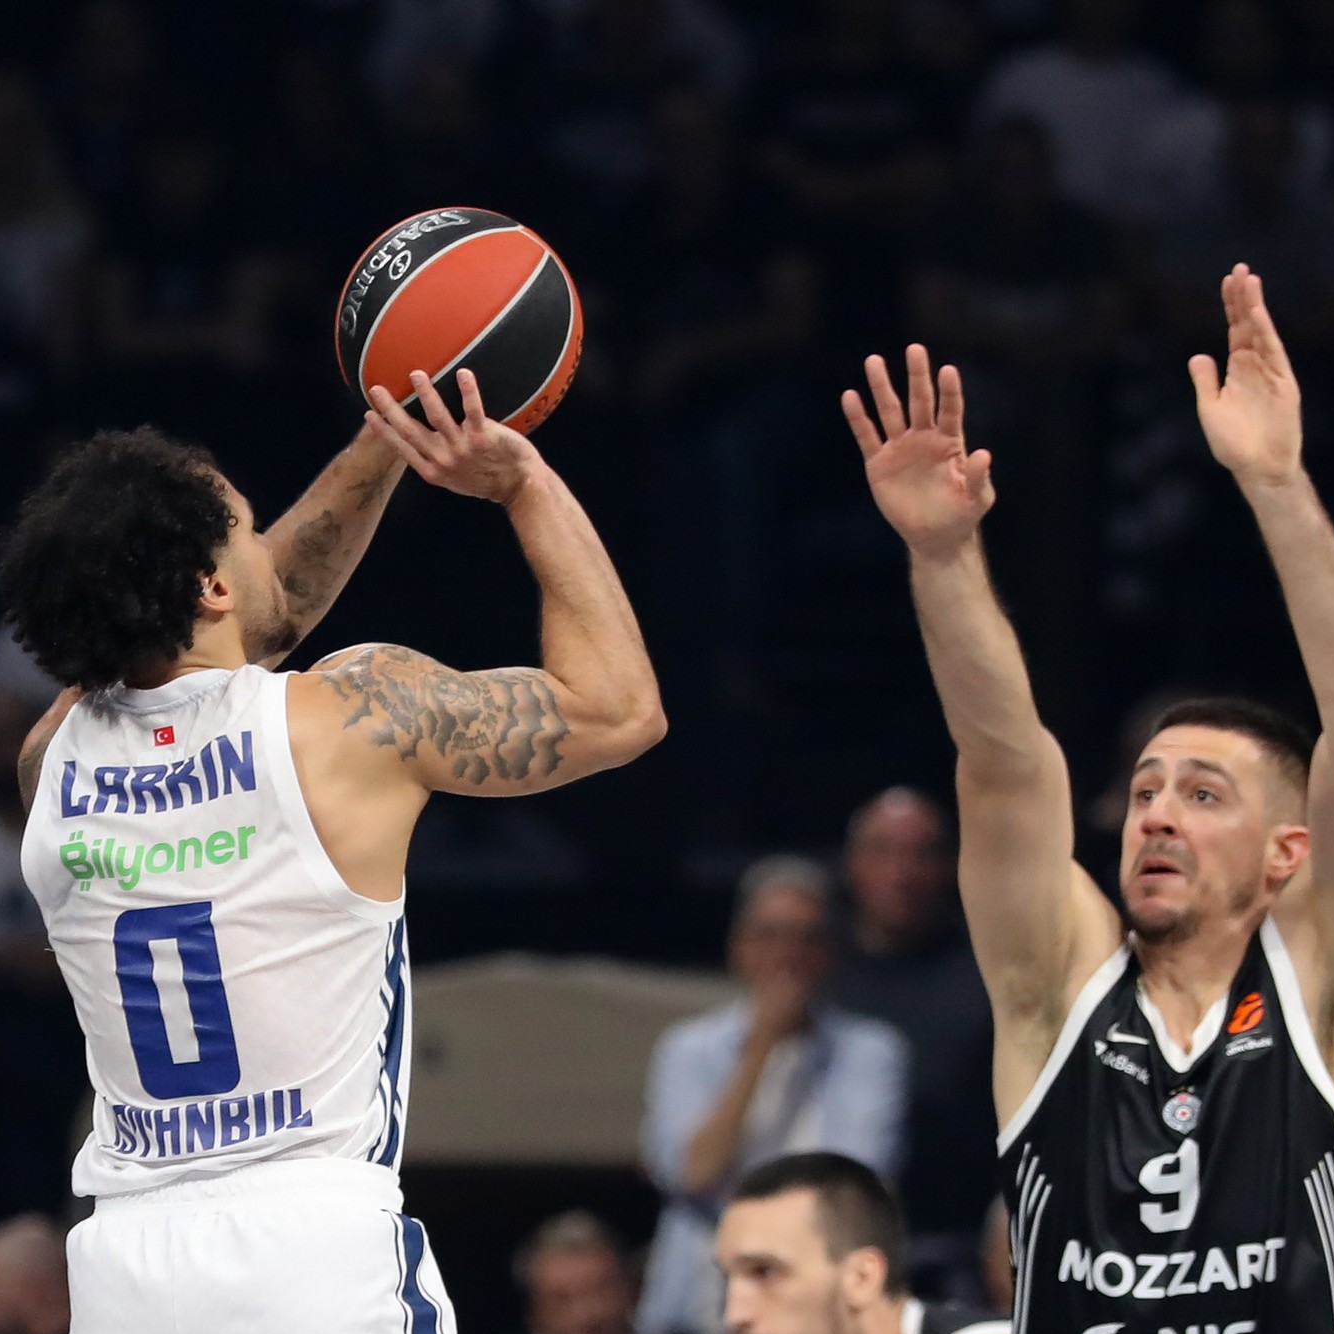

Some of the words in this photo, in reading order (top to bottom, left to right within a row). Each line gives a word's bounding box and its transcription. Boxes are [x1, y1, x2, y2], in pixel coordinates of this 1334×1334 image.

[61, 731, 257, 818] LARKIN
[59, 825, 256, 892] Bilyoner
[114, 901, 241, 1100] 0
[1139, 1138, 1200, 1233] 9
[1058, 1238, 1286, 1299] MOZZART
